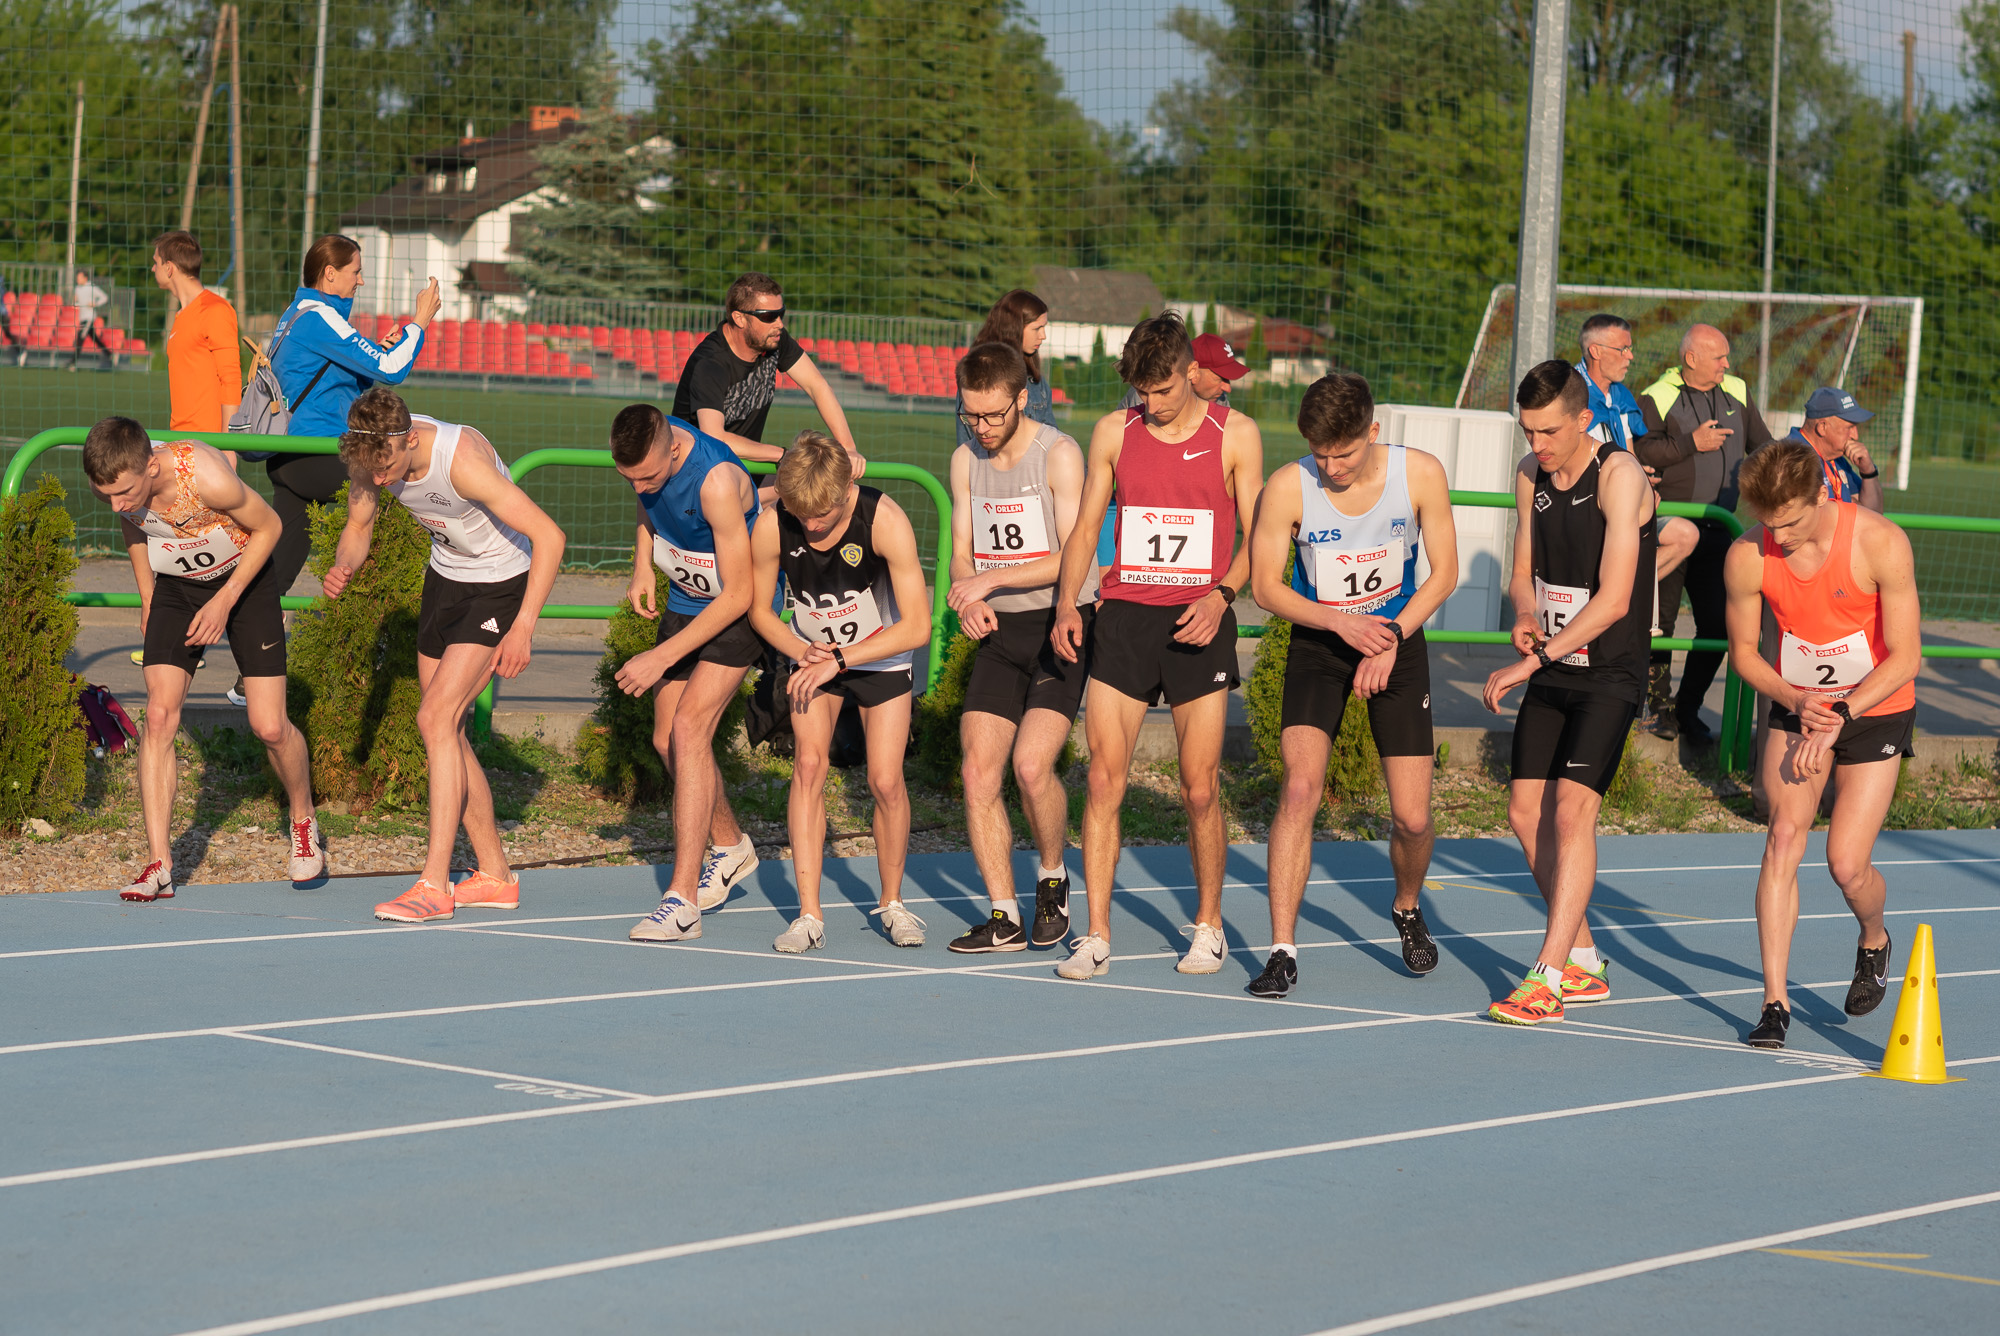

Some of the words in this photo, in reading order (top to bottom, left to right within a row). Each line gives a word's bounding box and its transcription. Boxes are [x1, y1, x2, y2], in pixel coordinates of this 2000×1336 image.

[996, 505, 1022, 513] ORLEN
[1163, 515, 1193, 524] ORLEN
[988, 523, 1024, 551] 18
[1307, 528, 1342, 544] AZS
[180, 540, 208, 550] ORLEN
[1147, 534, 1188, 563] 17
[848, 549, 857, 560] S
[1358, 551, 1386, 562] ORLEN
[174, 552, 216, 573] 10
[219, 560, 238, 574] 2021
[685, 556, 712, 568] ORLEN
[674, 566, 711, 593] 20
[1127, 573, 1179, 584] PIASECZNO
[1181, 576, 1202, 585] 2021
[1343, 567, 1382, 598] 16
[1376, 593, 1393, 605] 2021
[1548, 592, 1571, 602] ORLEN
[828, 605, 857, 618] ORLEN
[1543, 609, 1566, 638] 15
[820, 621, 859, 646] 19
[1817, 645, 1848, 657] ORLEN
[1564, 656, 1581, 665] 2021
[1815, 664, 1839, 685] 2
[494, 1082, 602, 1100] 200
